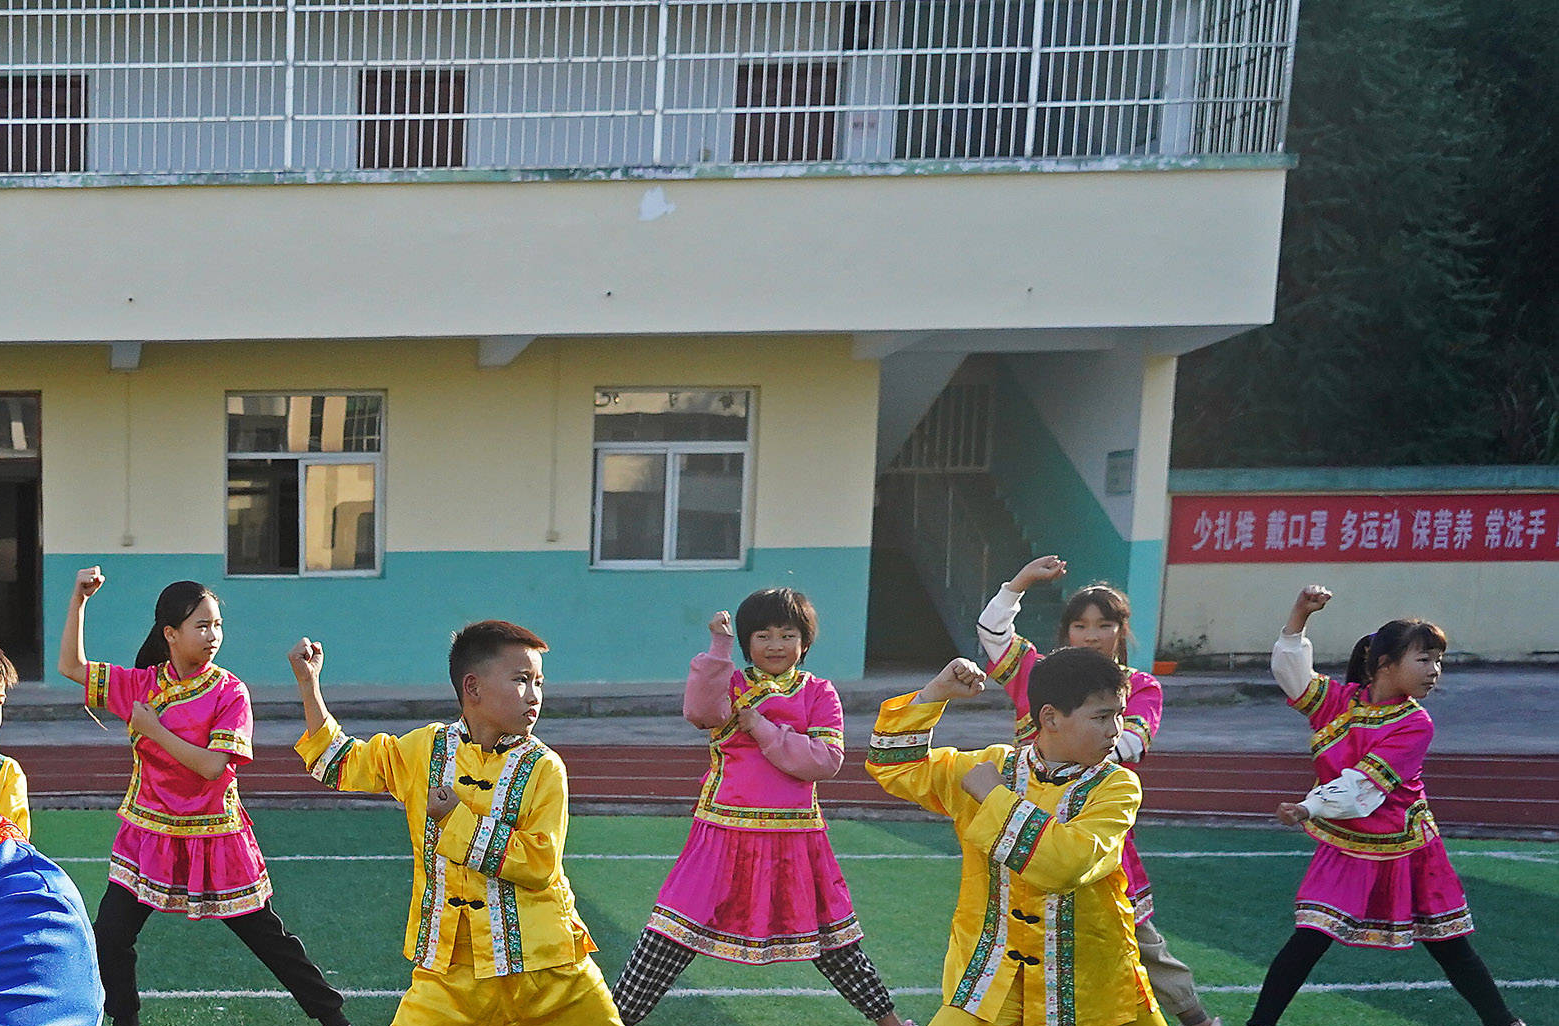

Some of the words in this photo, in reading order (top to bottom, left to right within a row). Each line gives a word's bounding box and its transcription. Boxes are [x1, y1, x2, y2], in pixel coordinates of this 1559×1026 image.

[1191, 509, 1256, 551] 少扎堆
[1265, 509, 1328, 551] 戴口罩
[1339, 508, 1402, 551] 多运动
[1412, 508, 1474, 550] 保营养
[1484, 507, 1546, 549] 常洗手
